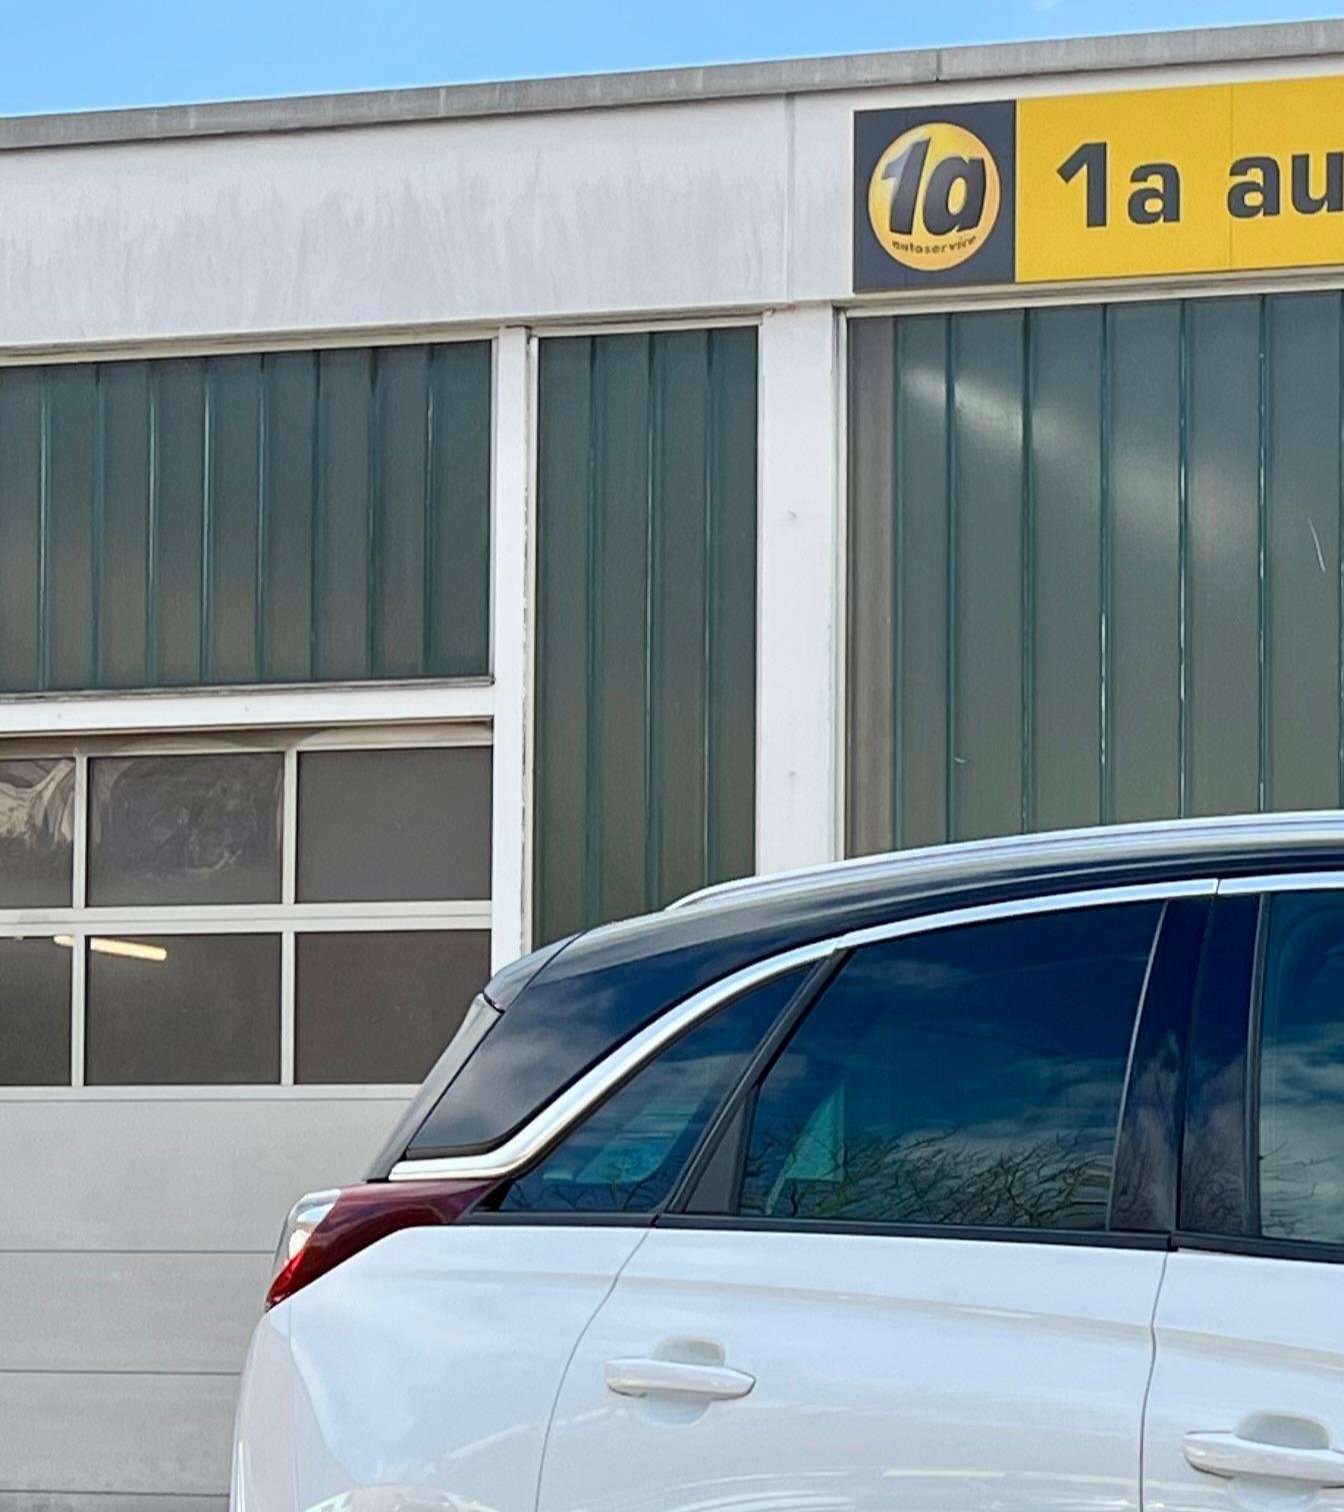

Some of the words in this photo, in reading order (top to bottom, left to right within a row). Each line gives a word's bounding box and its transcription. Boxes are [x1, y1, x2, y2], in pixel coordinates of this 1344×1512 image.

[882, 137, 987, 236] 1a
[1057, 141, 1181, 228] 1a
[891, 235, 977, 254] autoservice
